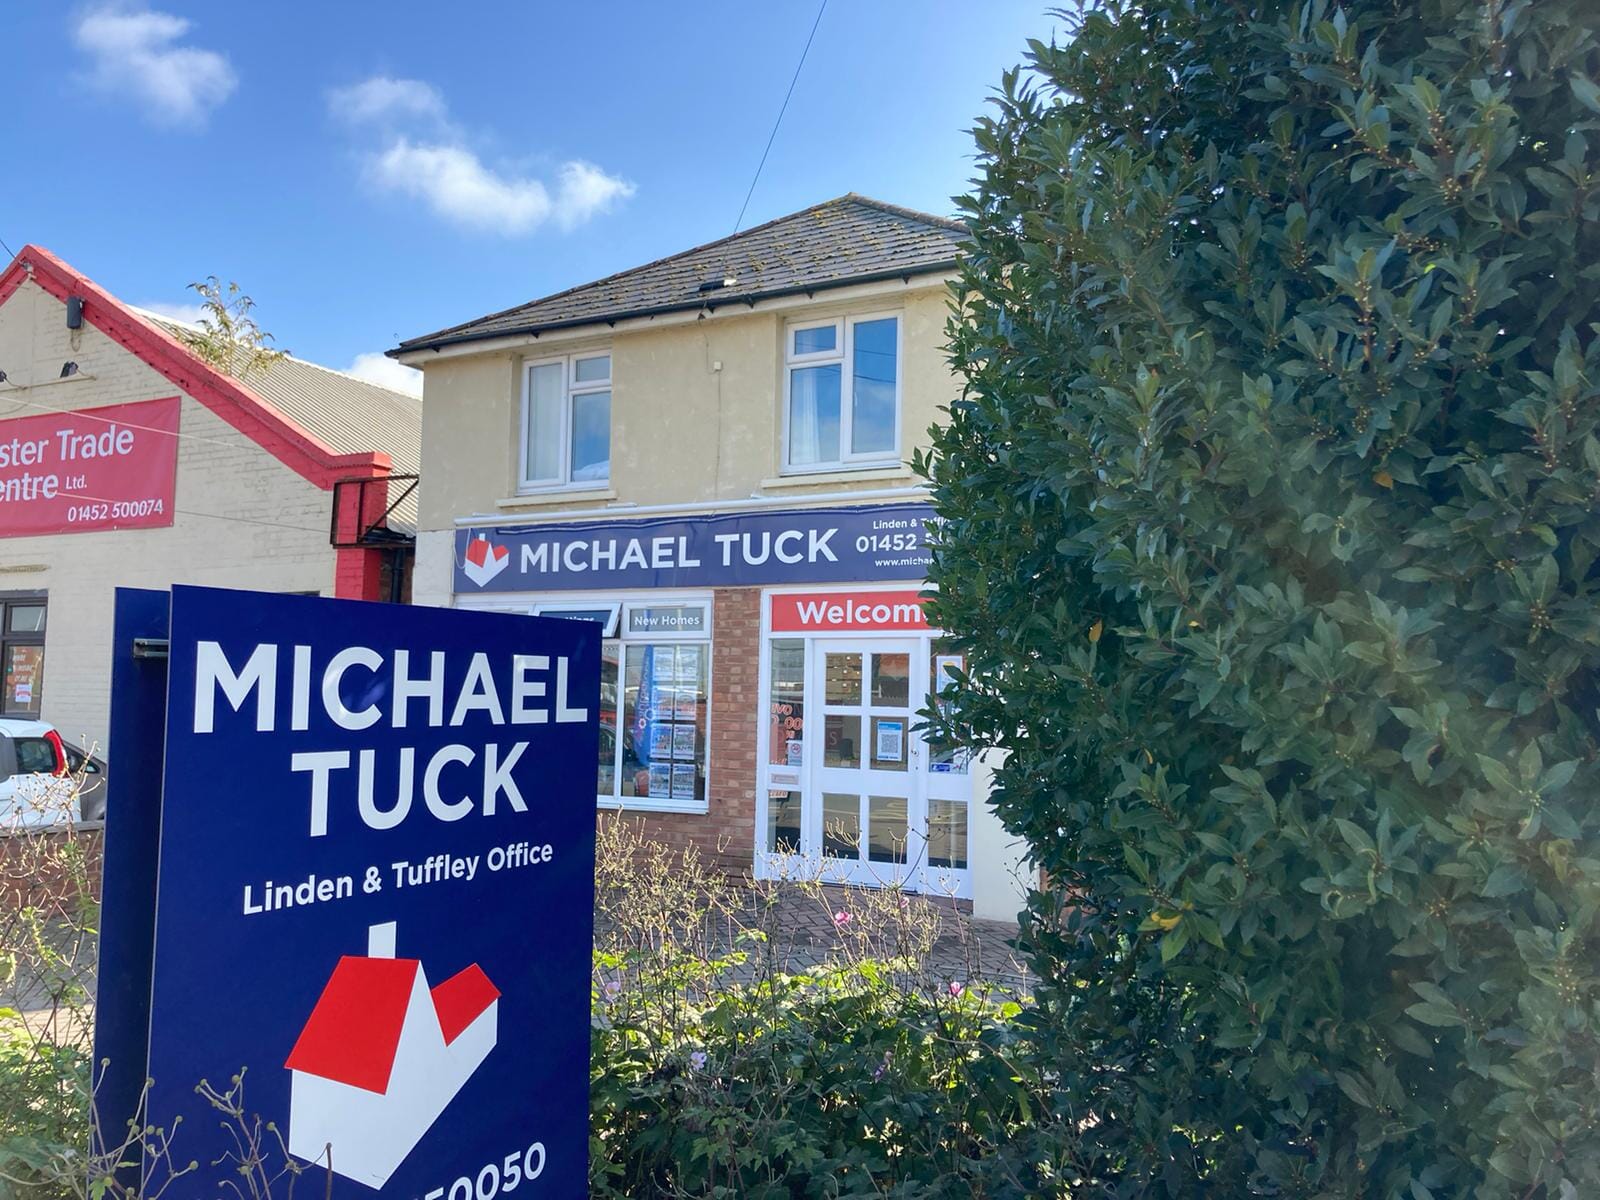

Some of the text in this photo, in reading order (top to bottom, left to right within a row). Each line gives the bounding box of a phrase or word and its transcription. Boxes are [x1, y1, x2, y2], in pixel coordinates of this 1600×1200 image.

[56, 424, 135, 461] Trade
[67, 499, 164, 522] 01452 500074
[873, 519, 908, 530] Linden
[910, 518, 918, 528] &
[520, 528, 839, 574] MICHAEL TUCK
[855, 533, 917, 553] 01452
[634, 615, 700, 626] New Homes
[796, 600, 928, 625] Welcom
[193, 641, 588, 734] MICHAEL
[291, 742, 530, 837] TUCK
[243, 842, 553, 915] Linden & Tuffley Office
